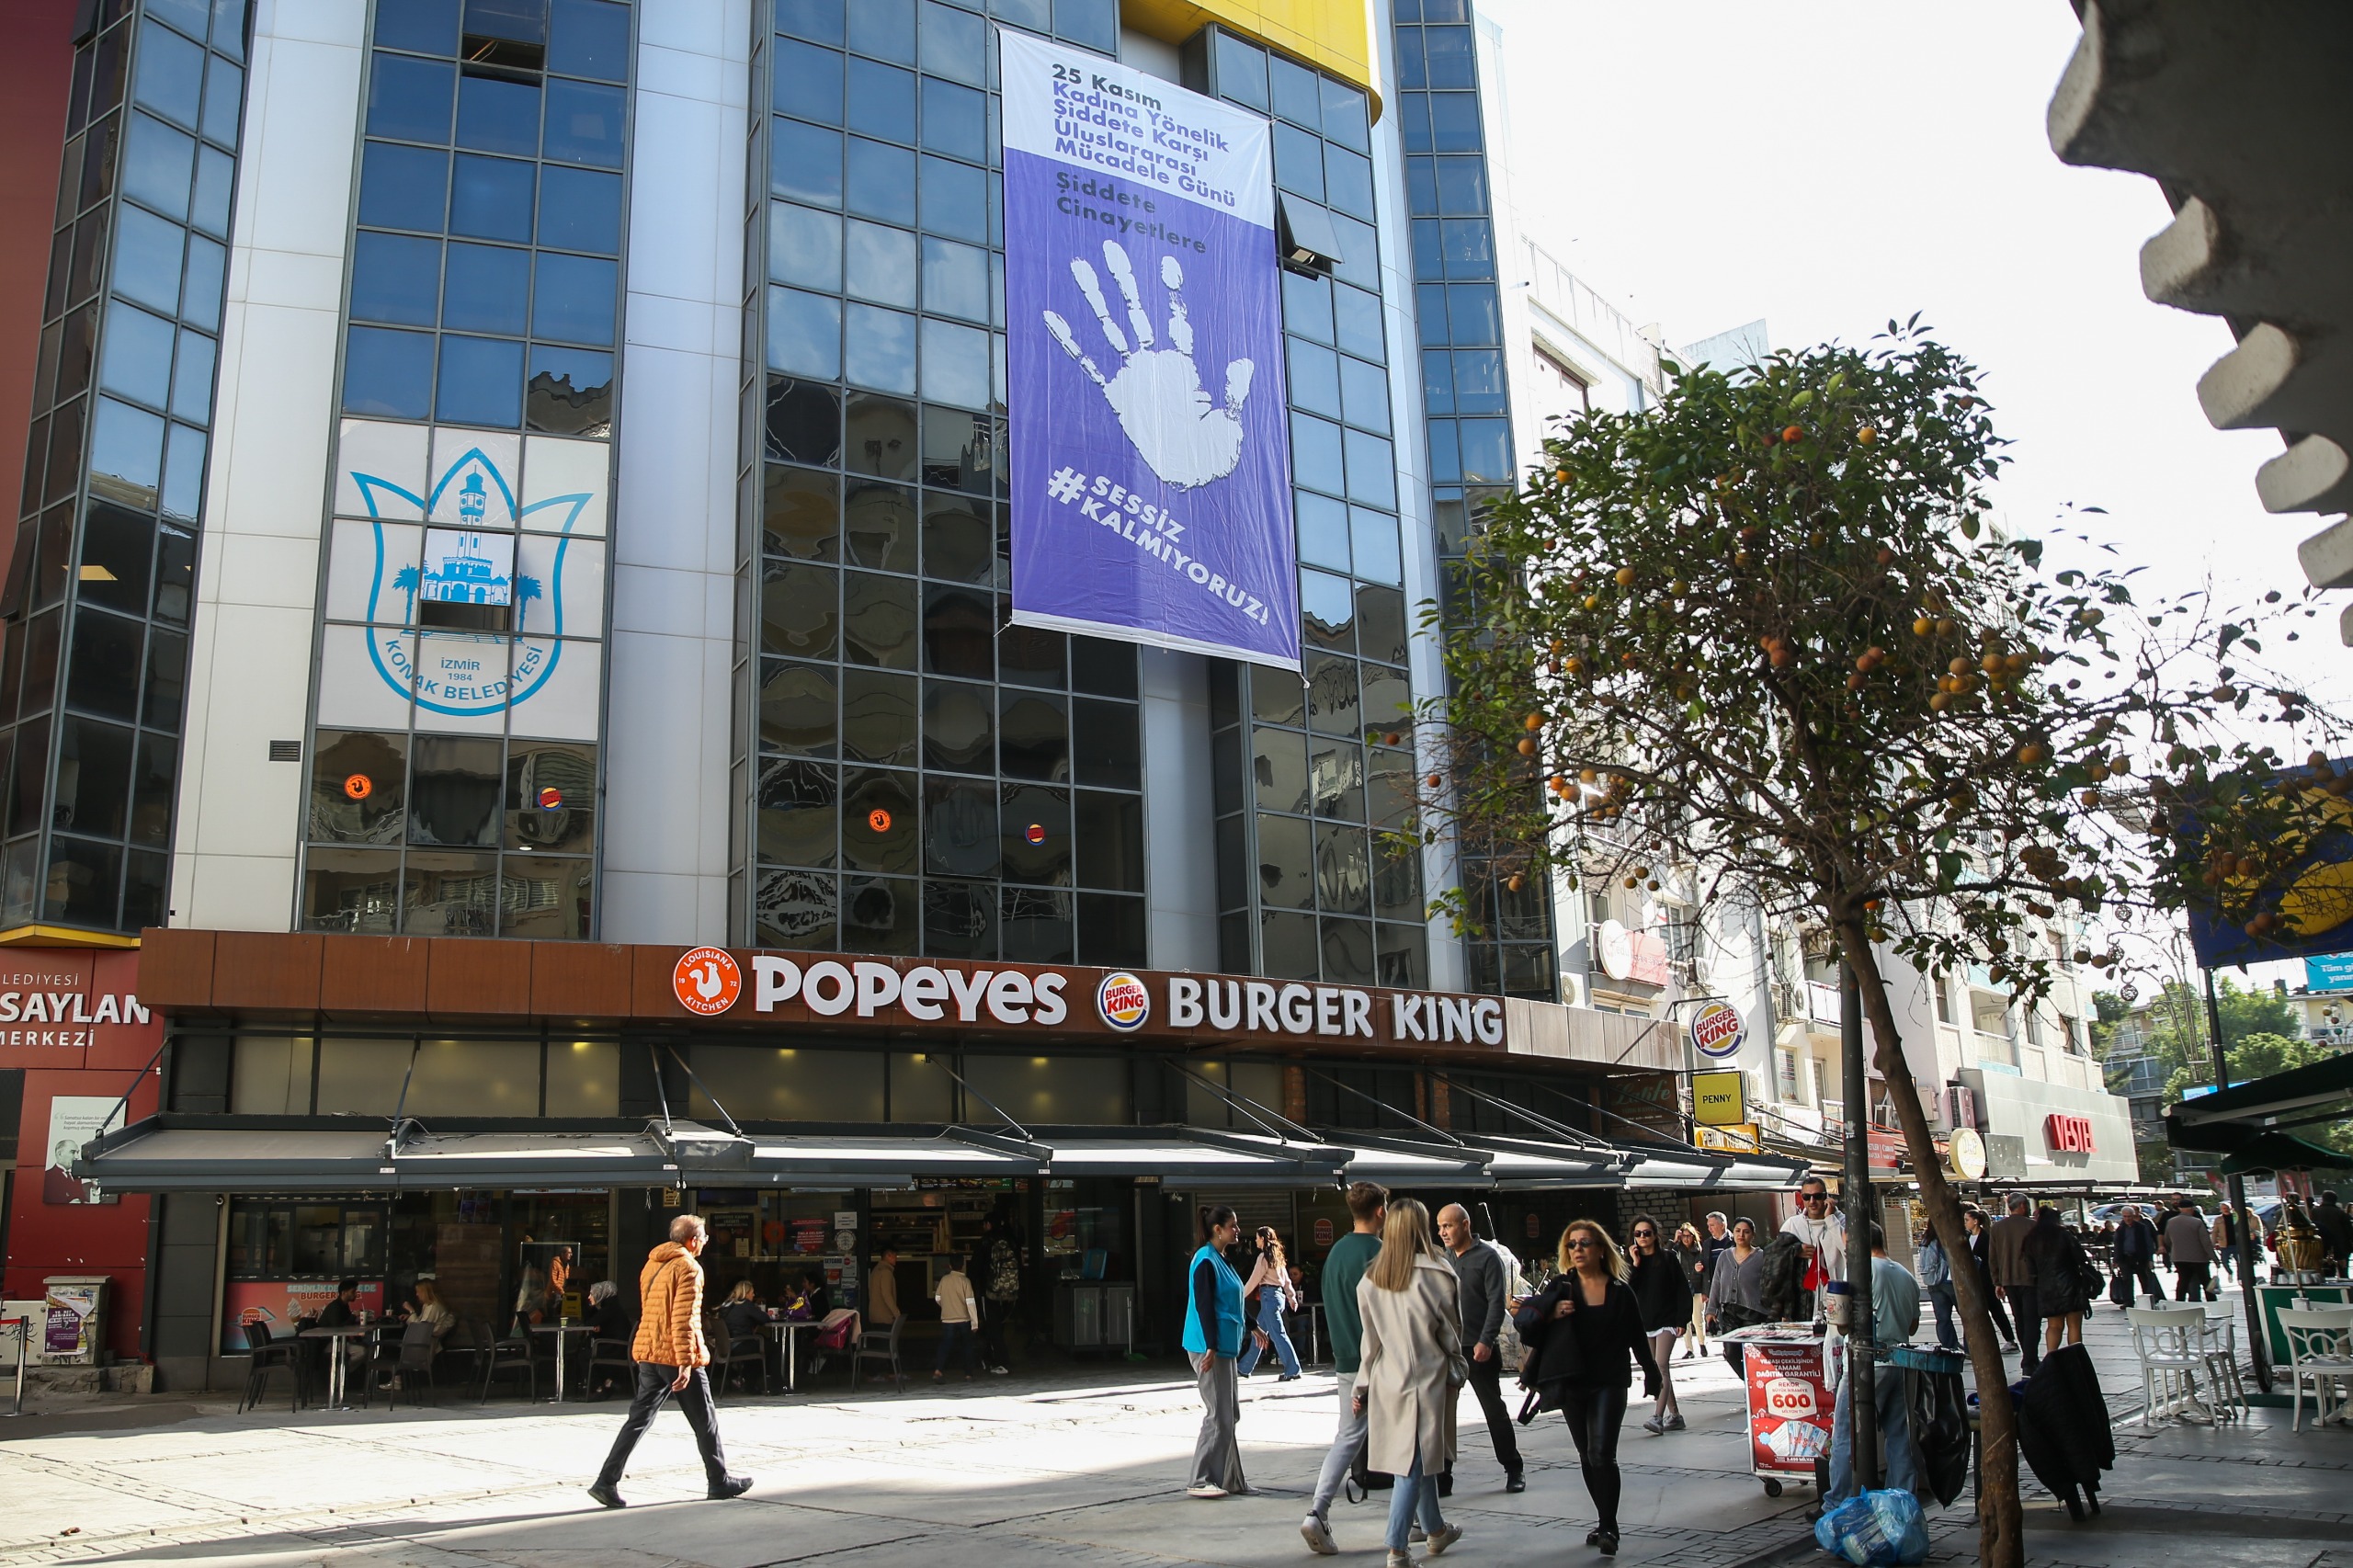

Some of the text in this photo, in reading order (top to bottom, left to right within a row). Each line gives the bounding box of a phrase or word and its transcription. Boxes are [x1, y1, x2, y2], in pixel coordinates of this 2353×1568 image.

[1052, 63, 1161, 111] 25 Kasım
[1053, 81, 1230, 153] Kadına Yönelik
[1054, 99, 1209, 162] Şiddete Karşı
[1054, 119, 1196, 176] Uluslararası
[1055, 138, 1235, 207] Mücadele Günü
[1057, 172, 1156, 214] Şiddete
[1057, 197, 1206, 254] Cinayetlere
[385, 639, 543, 700] KONAK BELEDİYESİ
[441, 657, 480, 671] İZMİR
[448, 673, 472, 681] 1984
[683, 950, 733, 971] LOUISIANA
[2320, 964, 2343, 972] Tüm
[3, 972, 79, 986] LEDİYESİ
[1106, 984, 1142, 1000] BURGER
[0, 992, 150, 1024] SAYLAN
[685, 994, 729, 1011] KITCHEN
[1107, 994, 1143, 1015] KING
[1167, 978, 1504, 1046] BURGER KING
[1696, 1009, 1734, 1035] BURGER
[1699, 1017, 1738, 1048] KING
[1702, 1094, 1732, 1105] PENNY
[2050, 1114, 2097, 1153] VESTEL
[1772, 1393, 1811, 1408] 600
